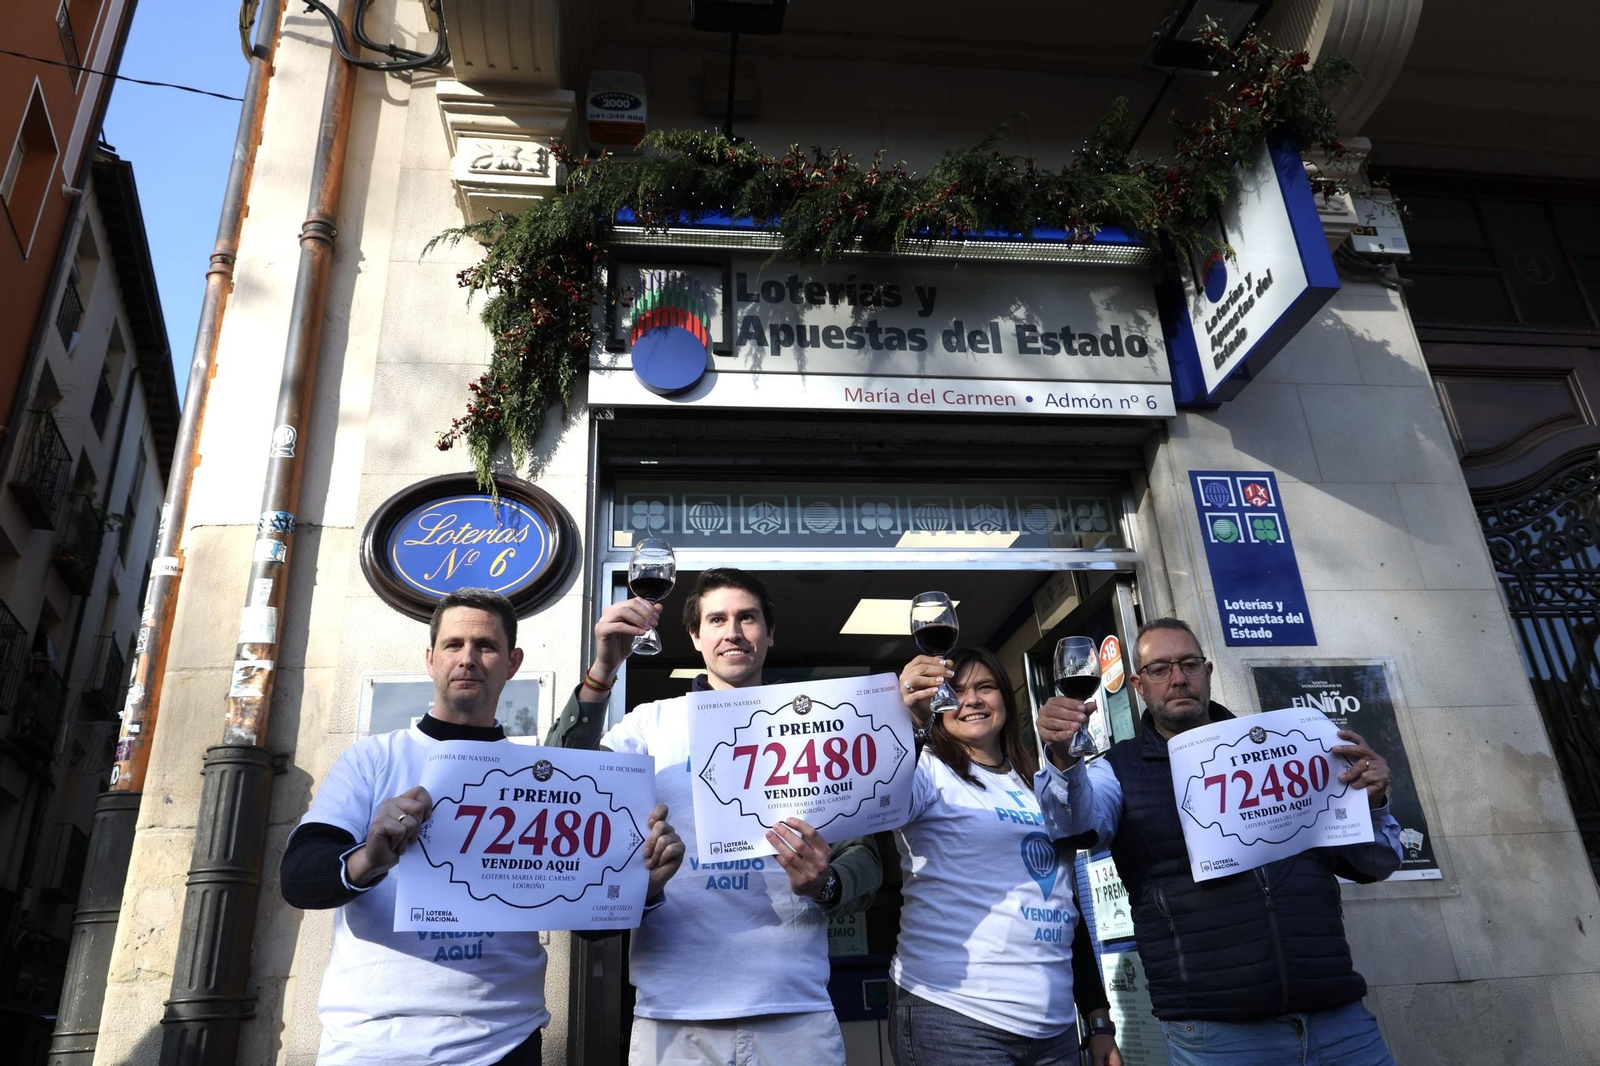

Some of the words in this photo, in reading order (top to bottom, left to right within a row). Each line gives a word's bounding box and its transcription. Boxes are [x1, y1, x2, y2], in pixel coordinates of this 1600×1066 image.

[602, 98, 630, 109] 2000
[736, 272, 903, 308] Loterías
[915, 286, 937, 317] y
[1204, 283, 1245, 334] Loterías
[1244, 271, 1252, 291] y
[1210, 294, 1255, 352] Apuestas
[1255, 268, 1274, 299] del
[735, 315, 928, 356] Apuestas
[942, 320, 1003, 354] del
[1016, 324, 1148, 358] Estado
[1213, 327, 1248, 370] Estado
[844, 387, 900, 404] María
[907, 388, 936, 404] del
[942, 390, 1016, 406] Carmen
[1045, 392, 1113, 409] Admón
[1145, 395, 1157, 409] 6
[489, 547, 516, 578] 6
[1224, 599, 1274, 610] Loterías
[1273, 601, 1283, 612] y
[1229, 613, 1284, 626] Apuestas
[1285, 612, 1304, 624] del
[1230, 627, 1273, 639] Estado
[1102, 640, 1117, 661] +18
[871, 685, 896, 694] DICIEMBRE
[697, 702, 723, 710] LOTERÍA
[733, 699, 761, 707] NAVIDAD
[1305, 690, 1361, 715] Niño
[779, 719, 844, 736] PREMIO
[429, 753, 456, 762] LOTERÍA
[468, 755, 500, 763] NAVIDAD
[732, 733, 877, 790] 72480
[1243, 744, 1297, 765] PREMIO
[615, 766, 646, 774] DICIEMBRE
[764, 786, 821, 800] VENDIDO
[822, 780, 853, 795] AQUÍ
[1204, 755, 1330, 814] 72480
[513, 788, 582, 805] PREMIO
[827, 795, 851, 803] CARMEN
[796, 806, 825, 815] LOGROÑO
[995, 807, 1044, 826] PREM
[1239, 804, 1287, 821] VENDIDO
[1289, 795, 1312, 811] AQUÍ
[454, 805, 611, 858] 72480
[723, 840, 748, 848] LOTERÍA
[724, 845, 754, 853] NACIONAL
[481, 858, 544, 870] VENDIDO
[545, 857, 580, 871] AQUÍ
[1212, 858, 1234, 866] LOTERÍA
[1214, 862, 1240, 870] NACIONAL
[512, 882, 545, 890] LOGROÑO
[705, 872, 749, 890] AQUÍ
[1103, 881, 1129, 902] PREM
[426, 909, 453, 917] LOTERÍA
[1021, 907, 1070, 924] VENDIDO
[828, 927, 855, 938] EMIO
[1034, 926, 1062, 943] AQUÍ
[434, 939, 484, 961] AQUÍ
